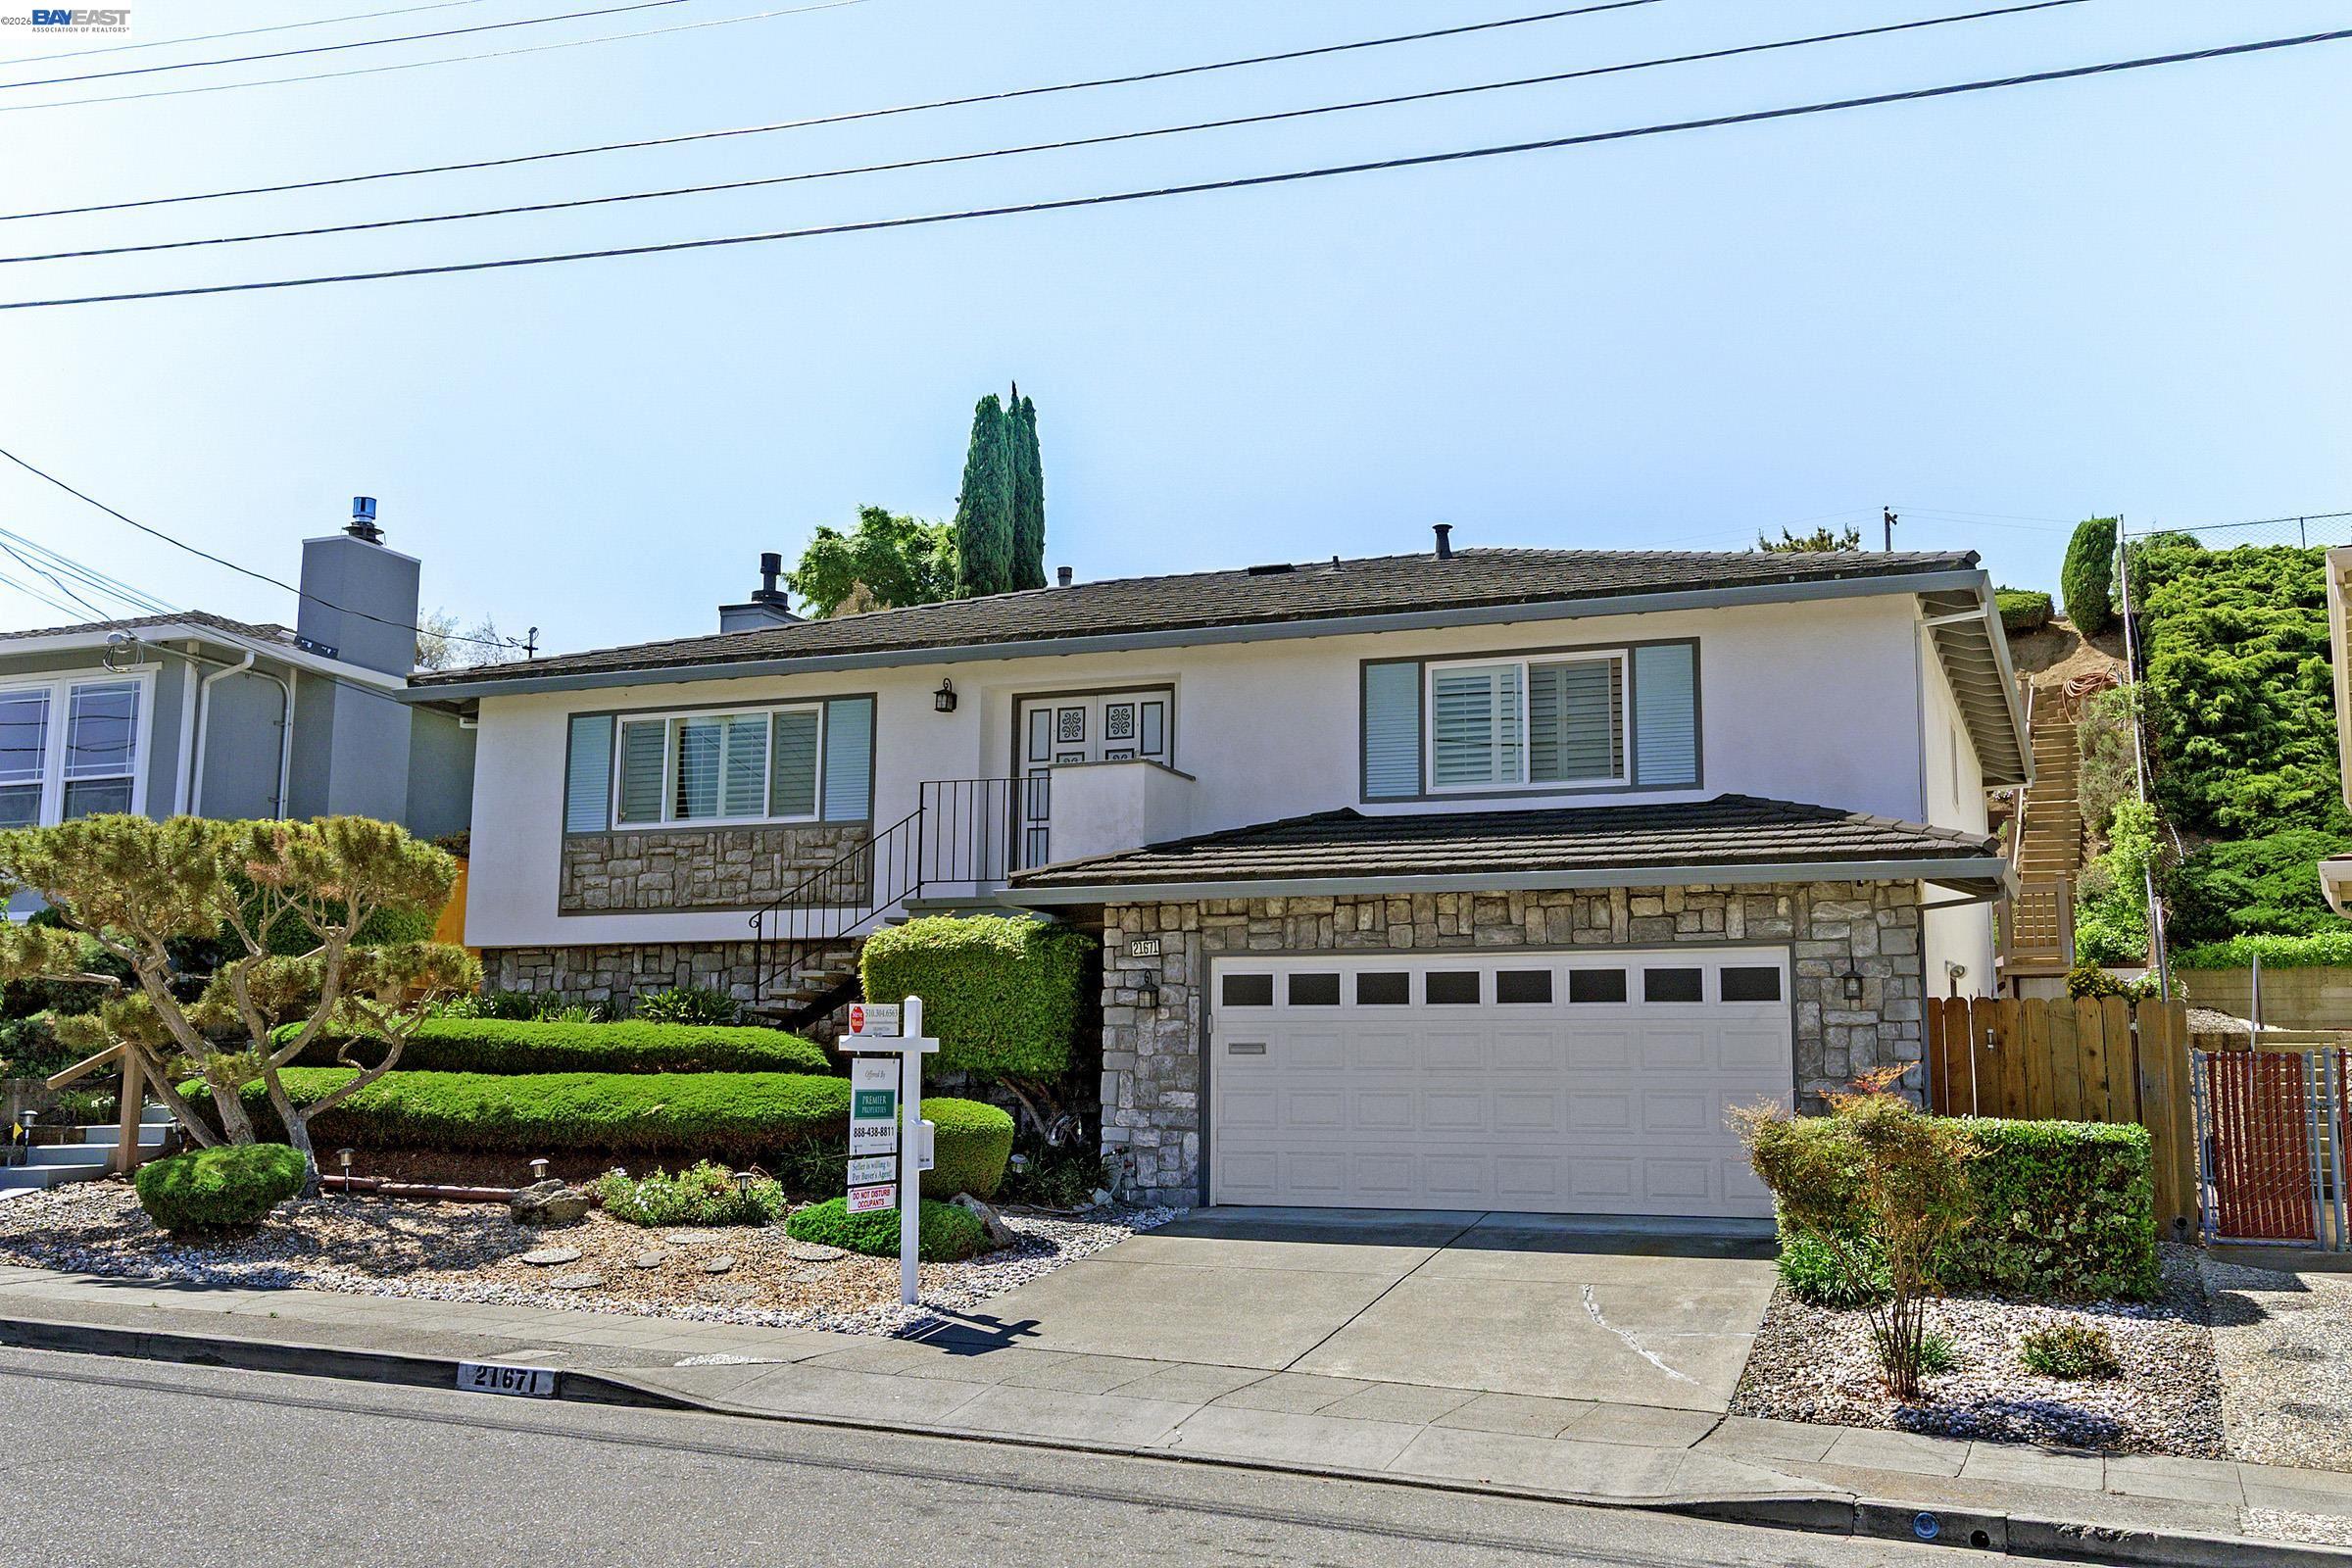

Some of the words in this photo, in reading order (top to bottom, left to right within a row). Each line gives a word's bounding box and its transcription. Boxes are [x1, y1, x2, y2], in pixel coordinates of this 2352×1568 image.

[1133, 941, 1158, 955] 21671
[861, 1095, 887, 1105] PREMIER
[854, 1126, 895, 1138] 888-438-8811
[853, 1161, 865, 1171] Seller
[871, 1159, 886, 1171] willing
[853, 1192, 859, 1200] DO
[860, 1191, 870, 1200] NOT
[871, 1189, 890, 1198] DISTURB
[858, 1198, 885, 1208] OCCUPANTS
[474, 1364, 538, 1393] 21671
